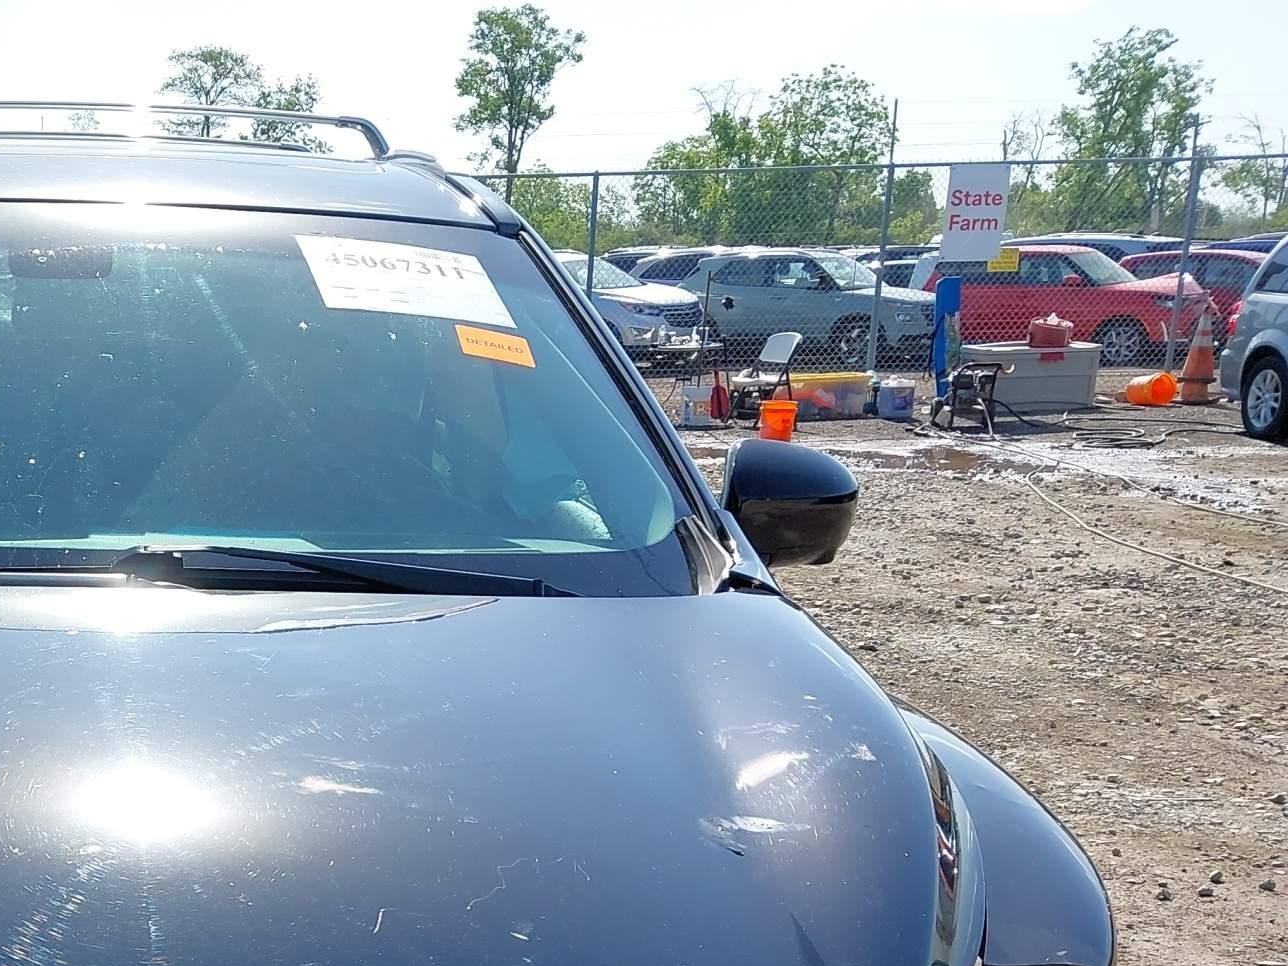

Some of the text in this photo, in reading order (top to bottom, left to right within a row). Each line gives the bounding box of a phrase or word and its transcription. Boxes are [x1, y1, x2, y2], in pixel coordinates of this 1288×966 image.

[950, 189, 1003, 207] State
[948, 214, 999, 231] Farm
[465, 336, 525, 355] DETAILED
